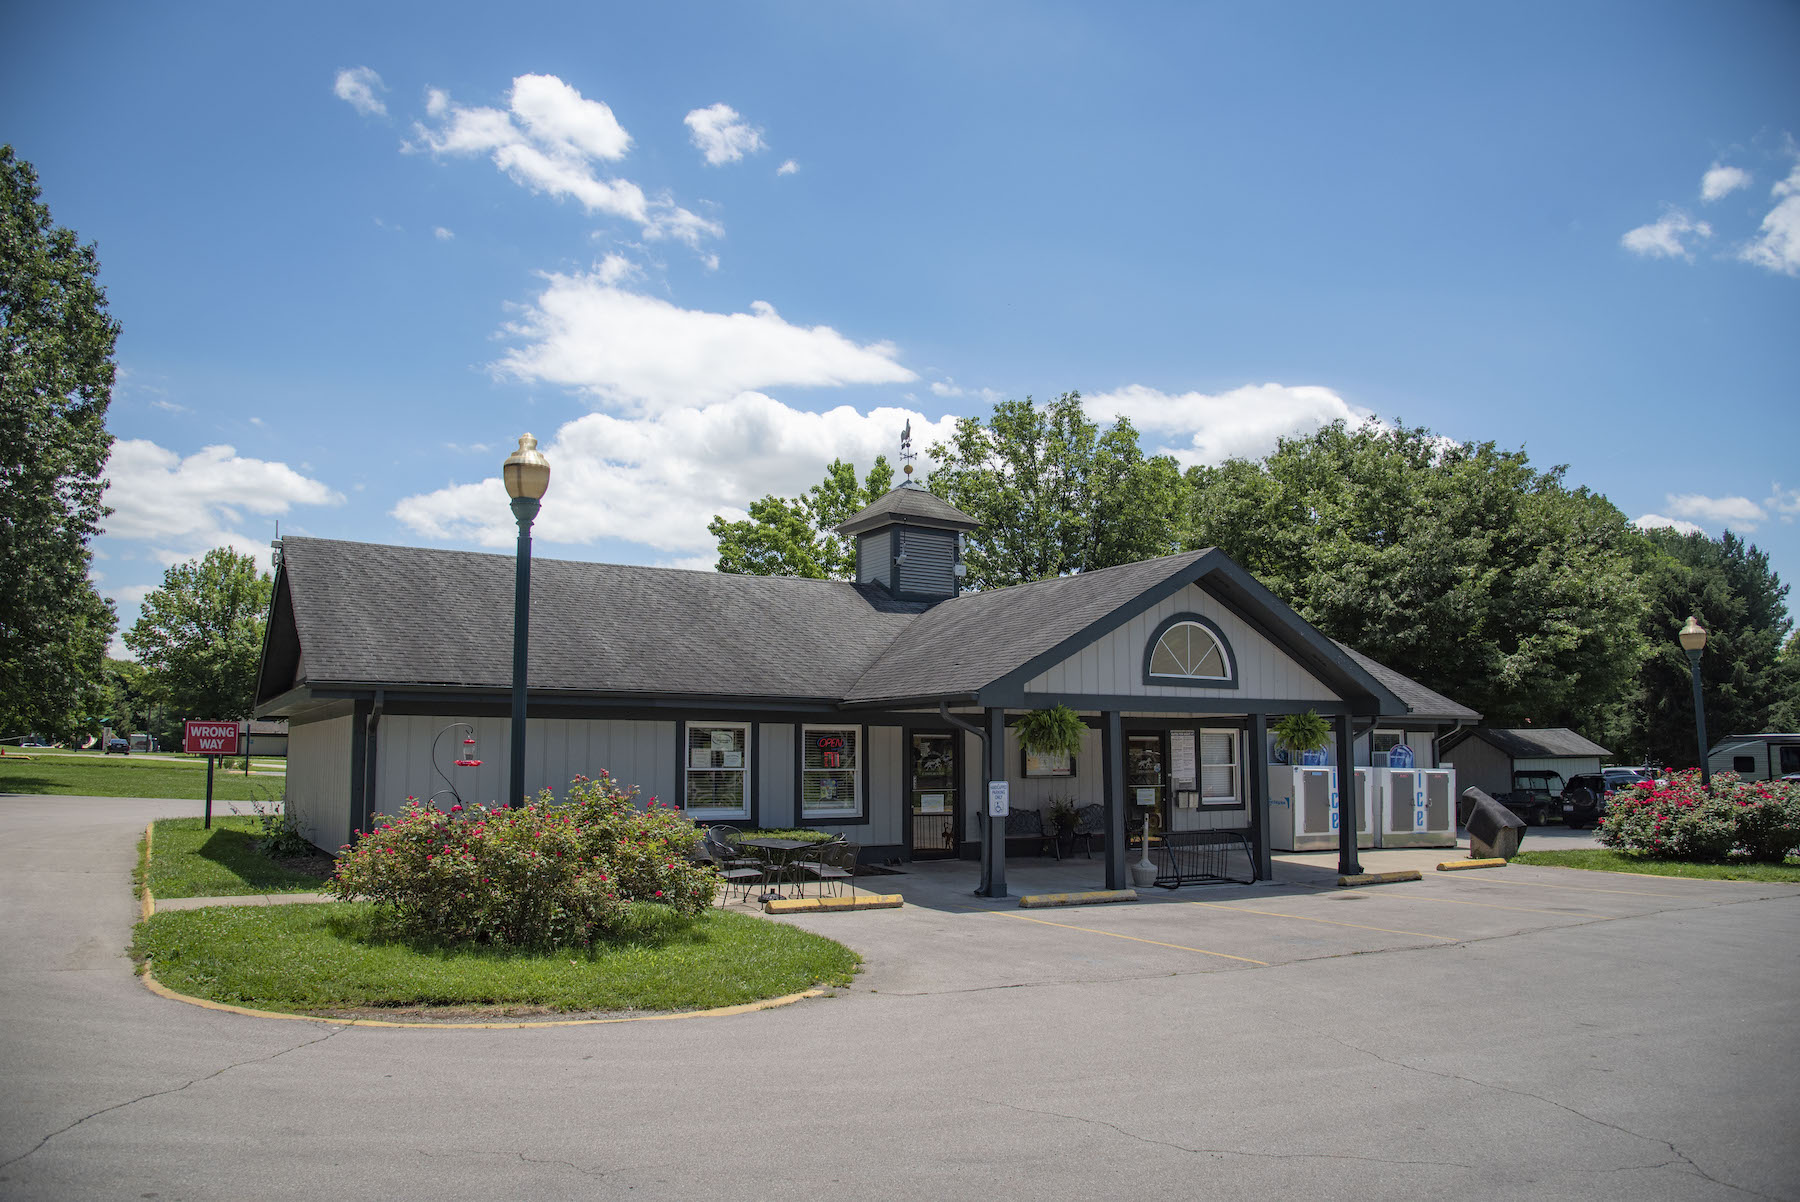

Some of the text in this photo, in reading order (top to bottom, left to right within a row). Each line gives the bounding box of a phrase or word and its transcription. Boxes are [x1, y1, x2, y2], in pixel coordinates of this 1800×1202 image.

[190, 726, 235, 738] WRONG
[199, 738, 225, 750] WAY
[819, 737, 843, 748] OPEN
[1331, 767, 1339, 829] ice
[1416, 769, 1424, 826] ice
